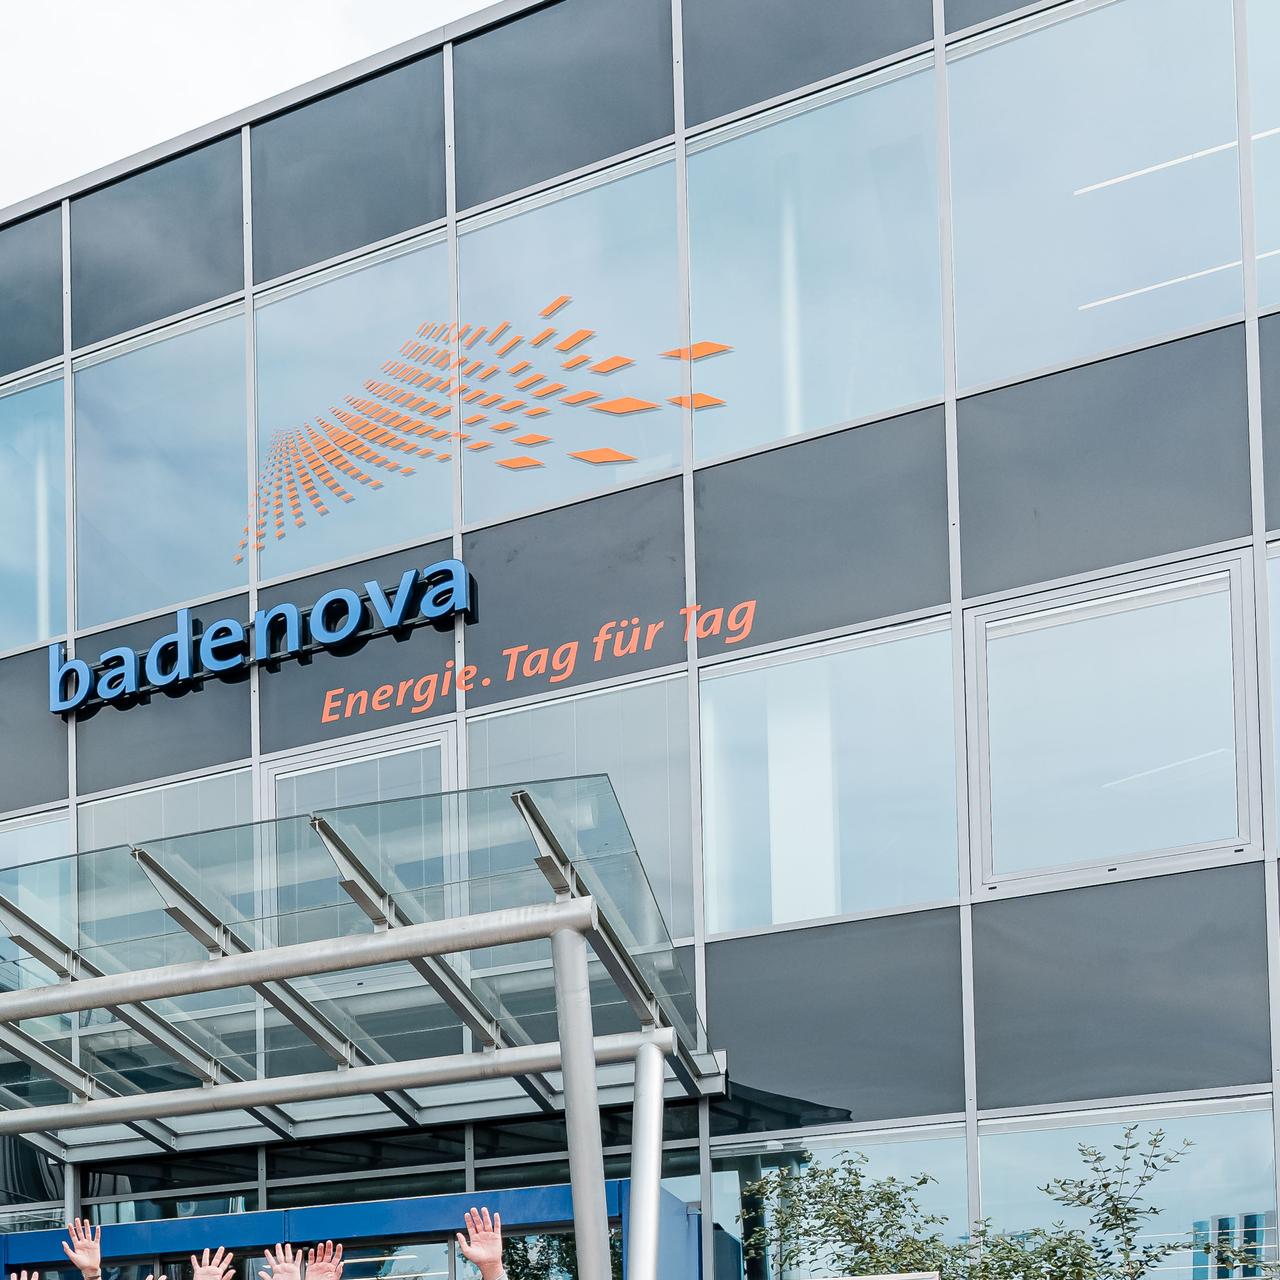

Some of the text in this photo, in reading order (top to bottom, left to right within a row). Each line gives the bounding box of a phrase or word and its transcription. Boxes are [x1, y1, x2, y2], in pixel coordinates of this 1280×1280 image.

[48, 558, 472, 714] badenova
[320, 599, 757, 724] Energie. Tag für Tag
